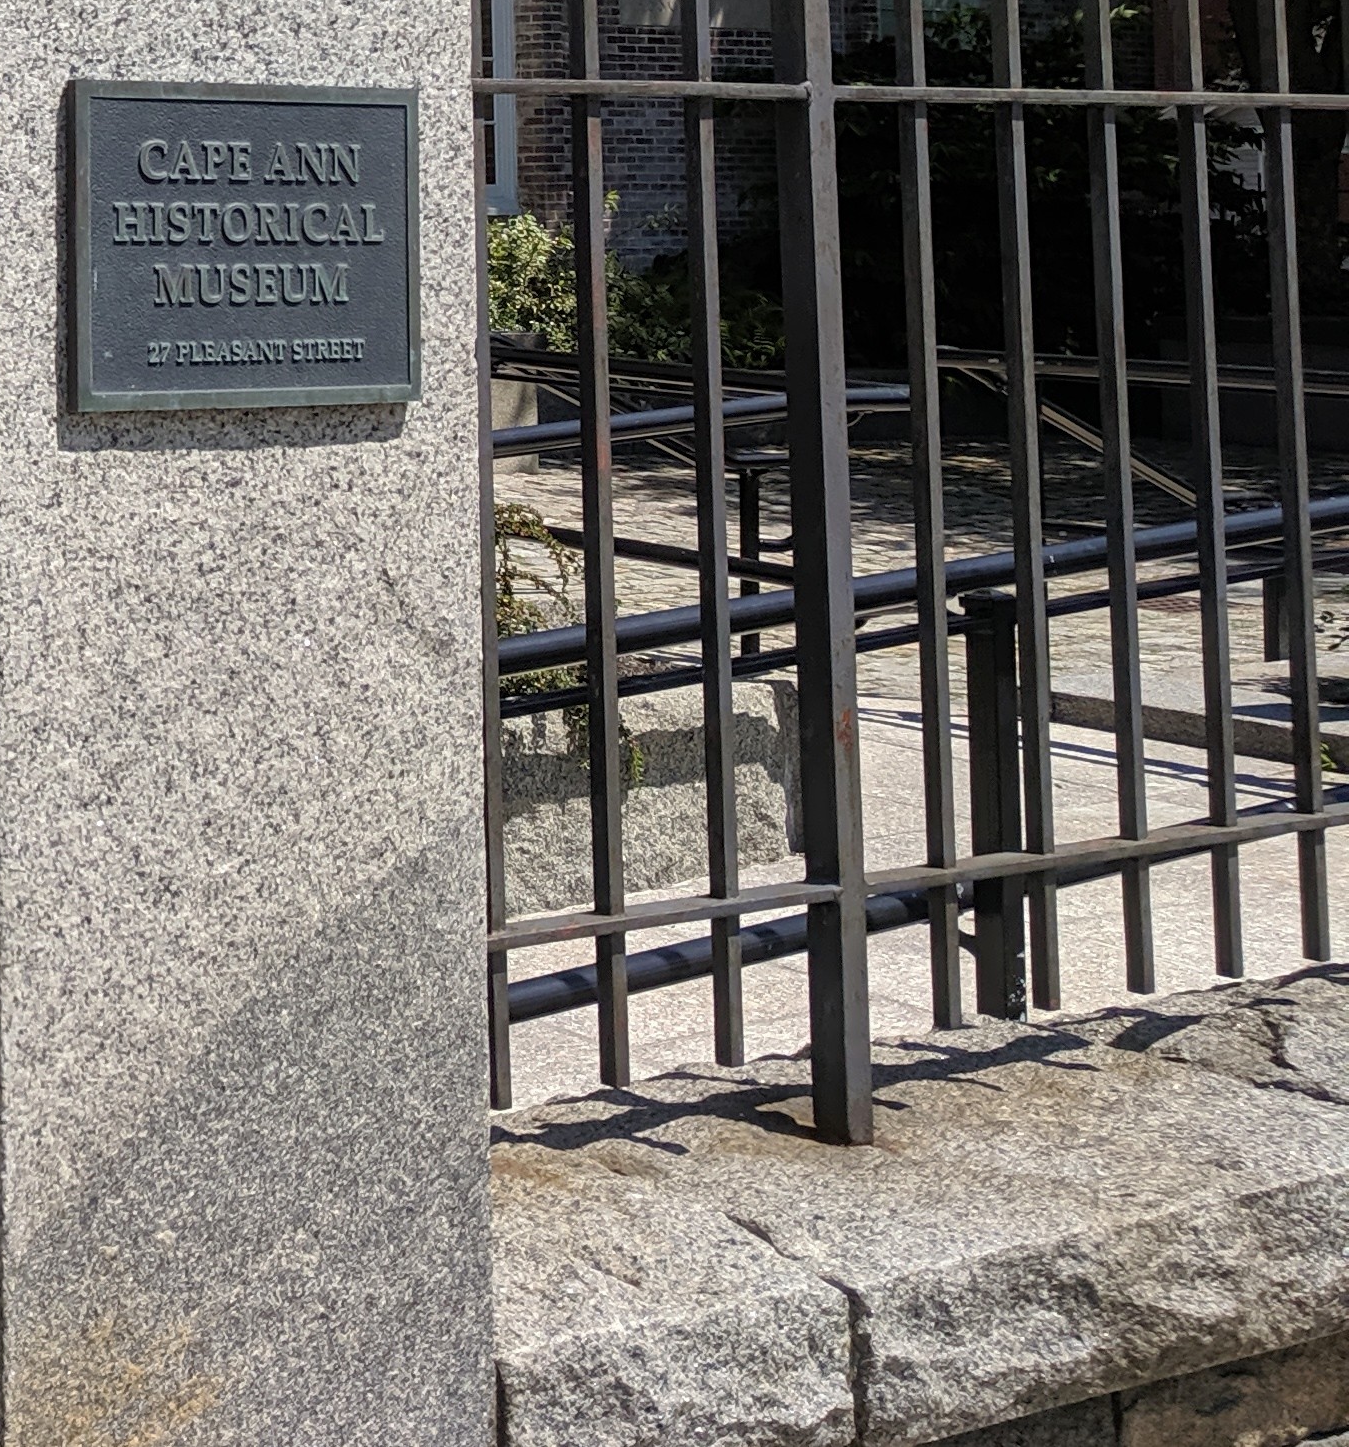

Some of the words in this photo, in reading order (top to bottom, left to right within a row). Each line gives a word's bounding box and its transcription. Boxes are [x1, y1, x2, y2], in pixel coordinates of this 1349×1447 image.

[138, 140, 252, 183] CAPE
[264, 141, 362, 185] ANN
[113, 201, 385, 245] HISTORICAL
[153, 263, 350, 306] MUSEUM
[148, 342, 171, 365] 27
[176, 340, 287, 364] PLEASANT
[292, 338, 366, 361] STREET
